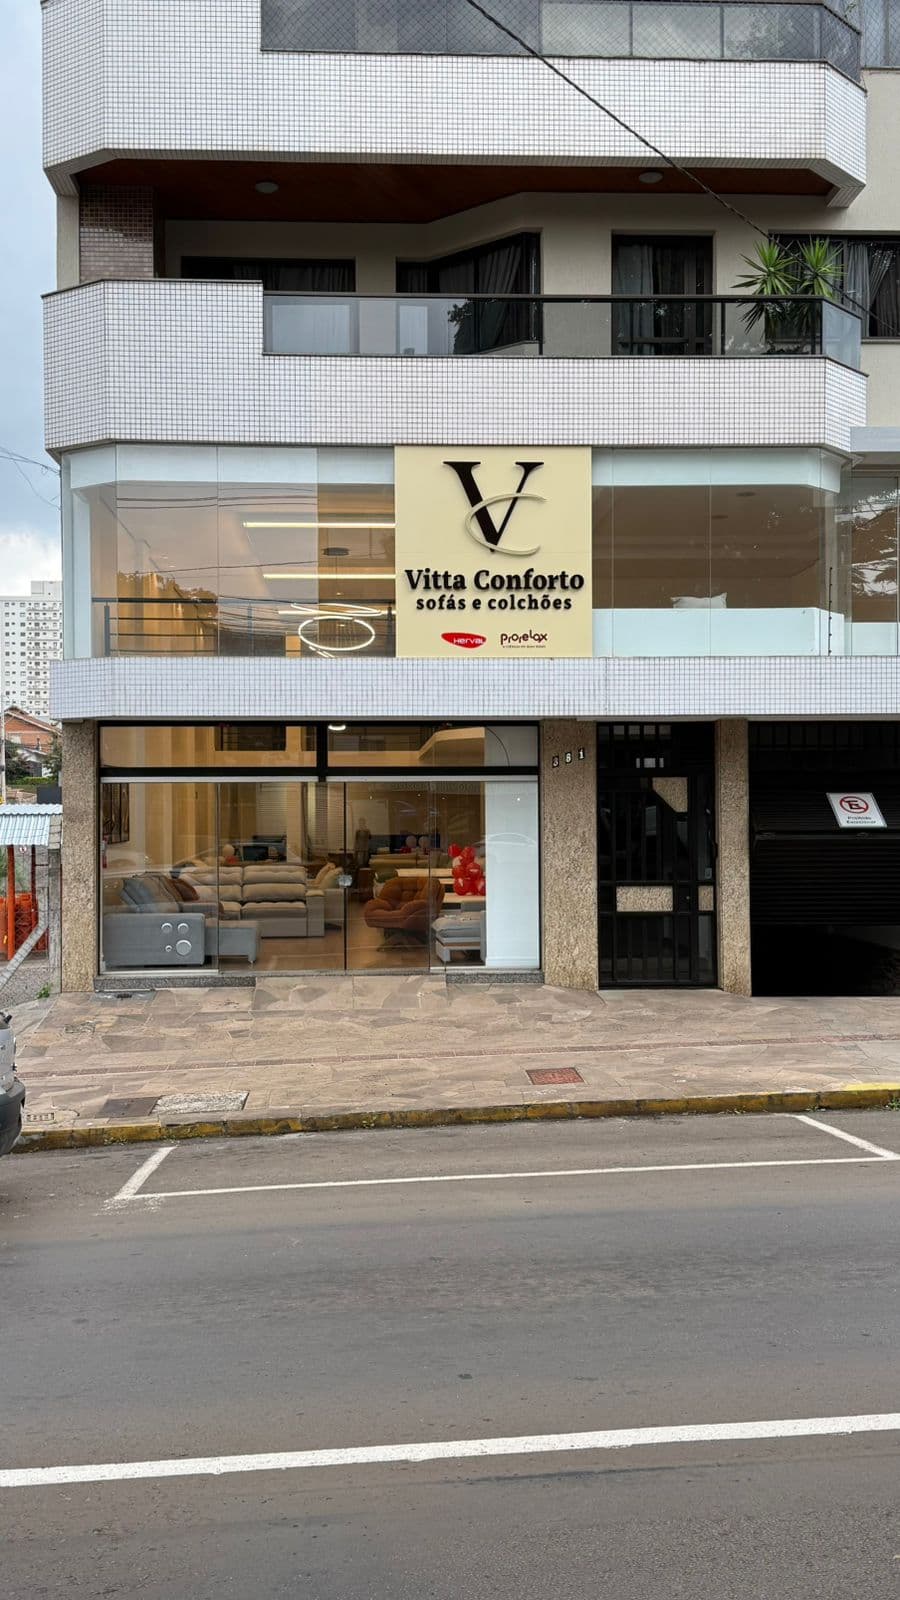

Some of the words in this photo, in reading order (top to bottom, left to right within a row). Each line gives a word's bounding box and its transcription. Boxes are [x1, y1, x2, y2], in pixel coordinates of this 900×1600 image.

[405, 568, 467, 590] Vitta
[473, 568, 585, 591] Conforto
[416, 594, 466, 610] sofás
[472, 597, 481, 610] e
[488, 594, 572, 610] colchões
